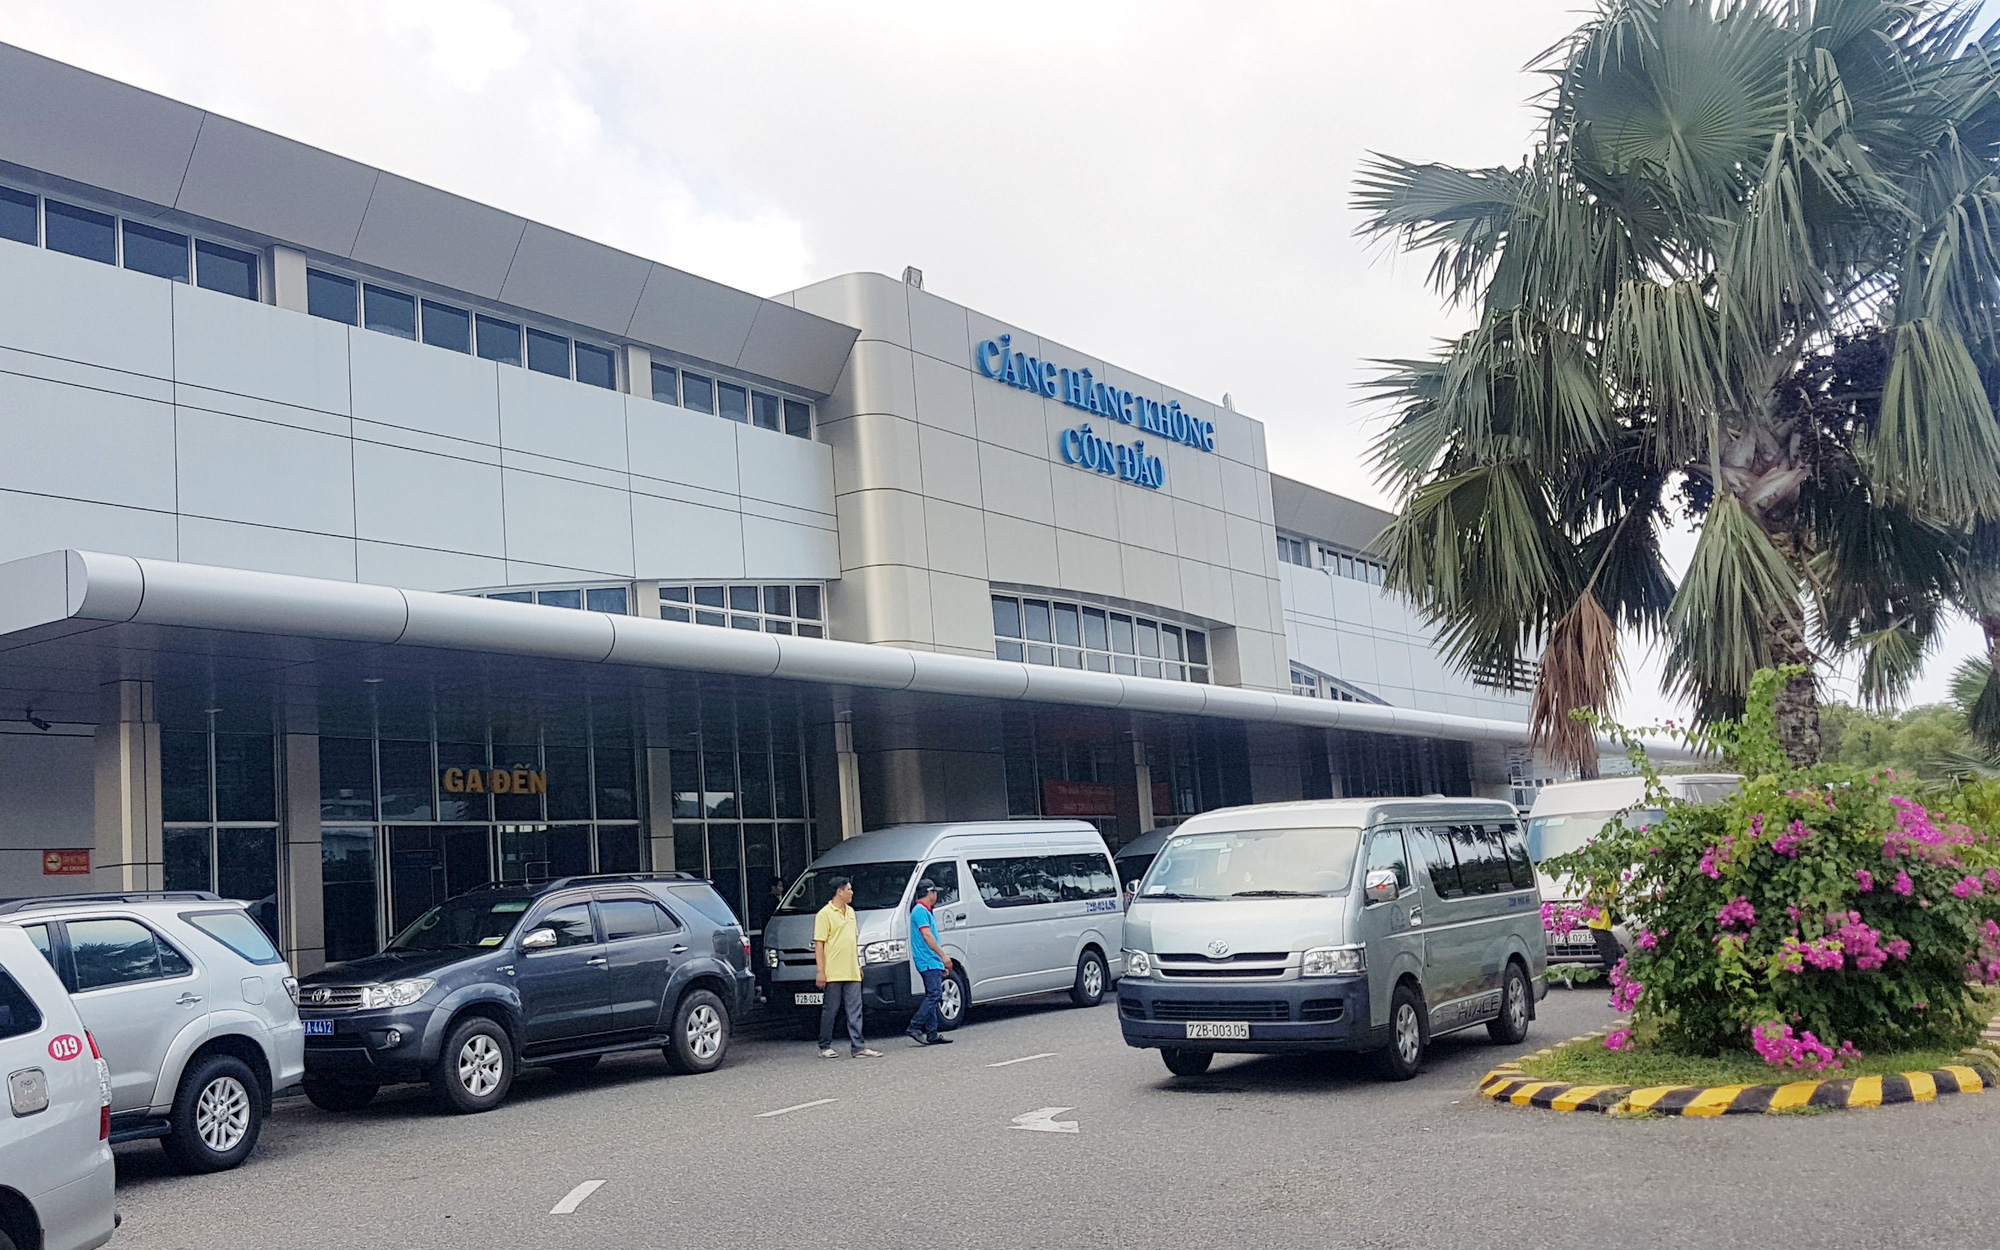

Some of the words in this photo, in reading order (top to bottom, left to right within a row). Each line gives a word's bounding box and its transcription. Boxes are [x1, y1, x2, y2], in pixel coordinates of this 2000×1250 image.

[977, 333, 1057, 398] CẢNG
[1061, 367, 1134, 424] HÀNG
[1136, 396, 1215, 452] KHÔNG
[1061, 422, 1117, 475] CÔN
[1119, 440, 1166, 489] ĐẢO
[443, 767, 484, 793] GA
[490, 762, 547, 794] ĐẾN
[53, 1036, 79, 1058] 019
